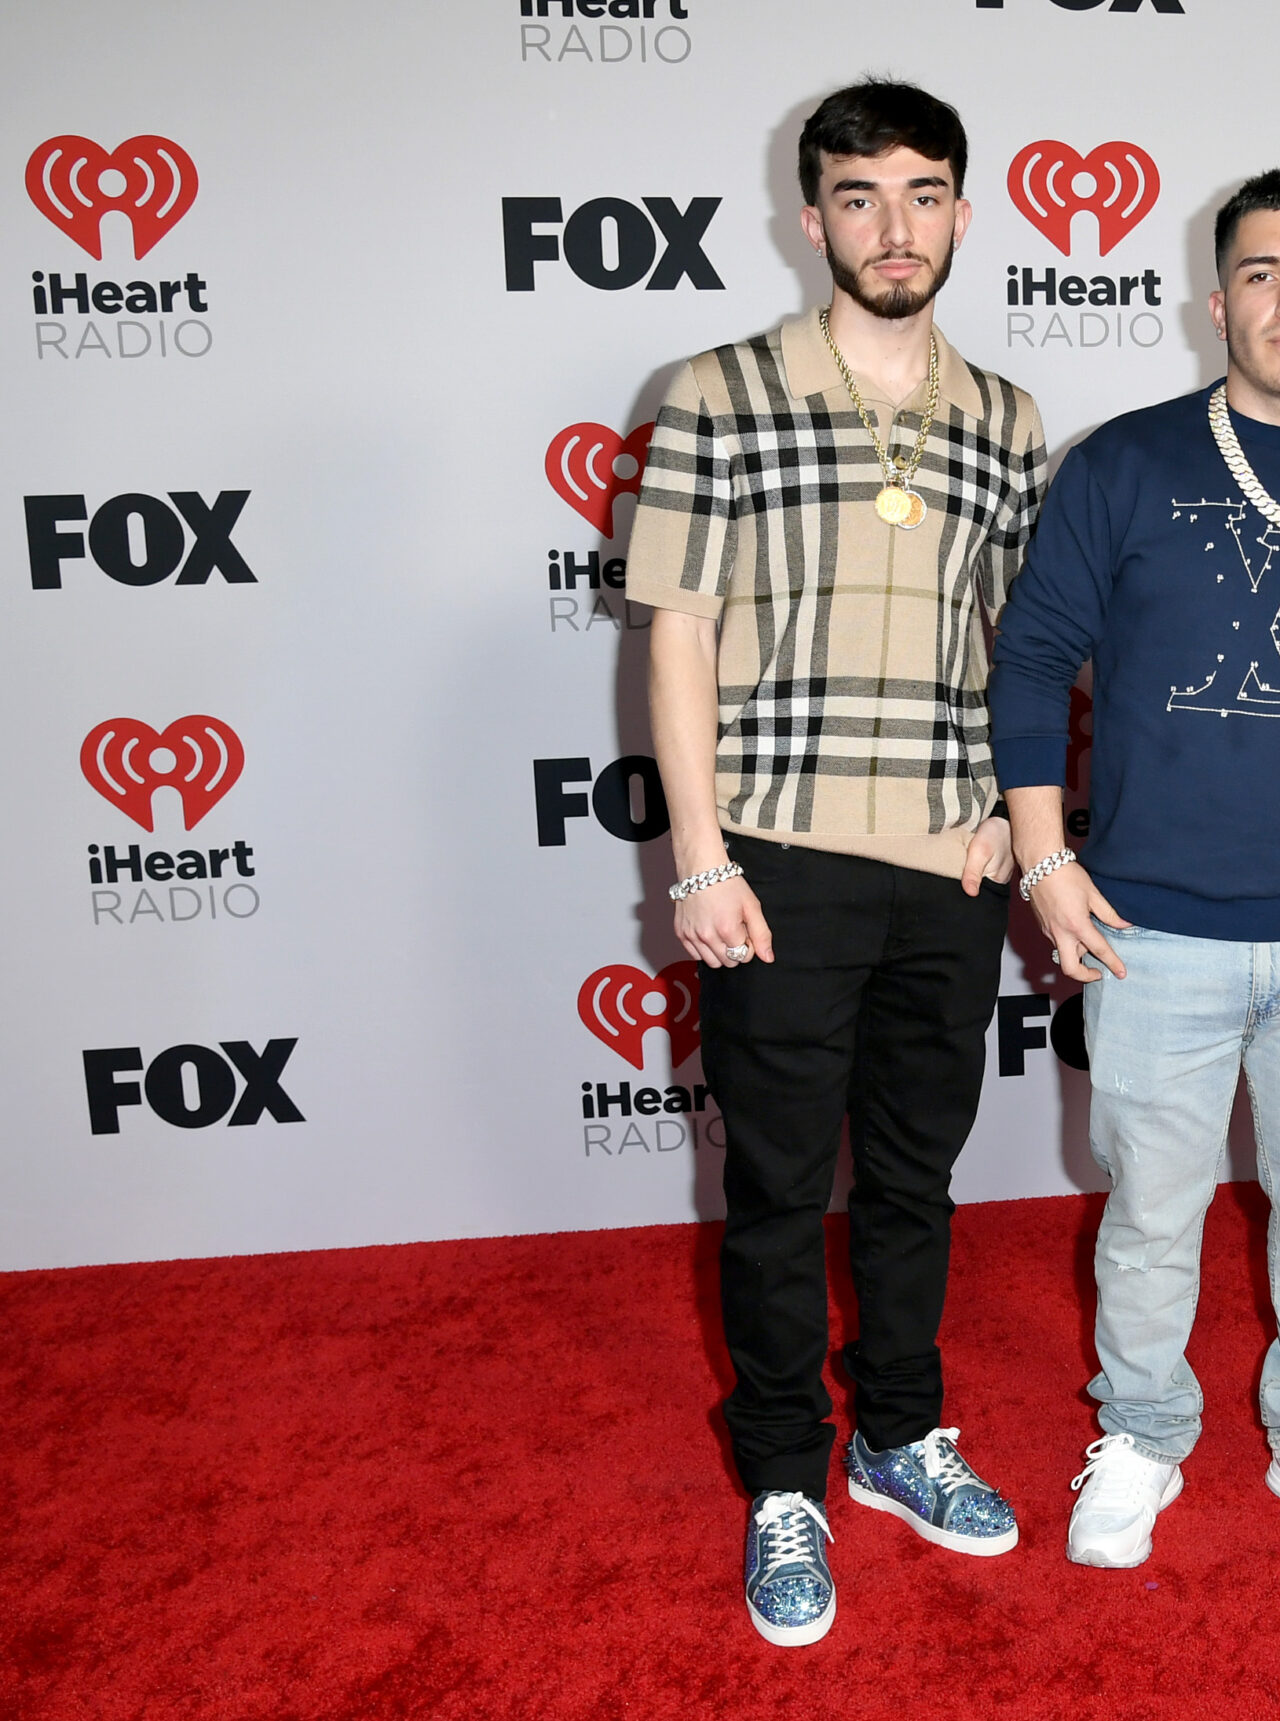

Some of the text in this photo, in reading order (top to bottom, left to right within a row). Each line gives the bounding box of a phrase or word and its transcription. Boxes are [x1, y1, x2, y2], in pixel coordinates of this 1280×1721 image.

[520, 24, 692, 64] RADIO
[502, 197, 726, 291] FOX
[32, 271, 208, 314] iHeart
[1007, 265, 1161, 306] iHeart
[35, 319, 213, 360] RADIO
[1007, 312, 1164, 348] RADIO
[23, 490, 258, 590] FOX
[548, 549, 627, 590] iHe
[550, 595, 653, 632] RAD
[533, 755, 672, 847] FO
[88, 841, 256, 884] iHeart
[91, 883, 260, 925] RADIO
[82, 1038, 306, 1135] FOX
[581, 1081, 711, 1118] iHear
